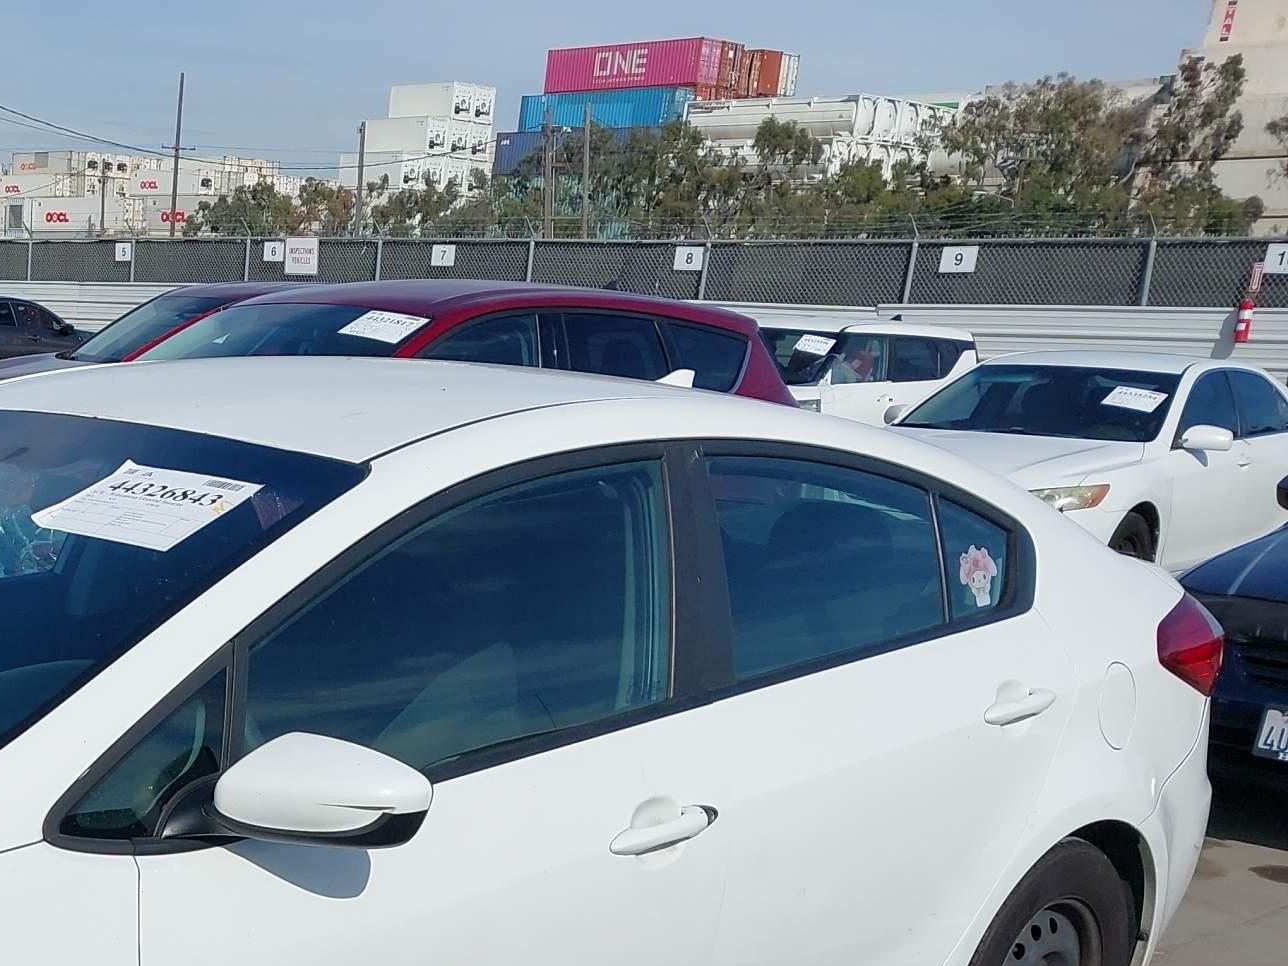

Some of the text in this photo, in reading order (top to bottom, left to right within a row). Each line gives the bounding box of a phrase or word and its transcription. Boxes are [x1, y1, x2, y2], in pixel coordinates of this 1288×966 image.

[593, 48, 648, 77] ONE
[4, 185, 20, 193] OOCL
[140, 180, 159, 189] OOCL
[45, 211, 69, 223] OOCL
[121, 246, 127, 257] 5
[270, 246, 277, 257] 6
[440, 249, 447, 261] 7
[685, 252, 694, 265] 8
[954, 252, 964, 267] 9
[109, 479, 224, 507] 44326843
